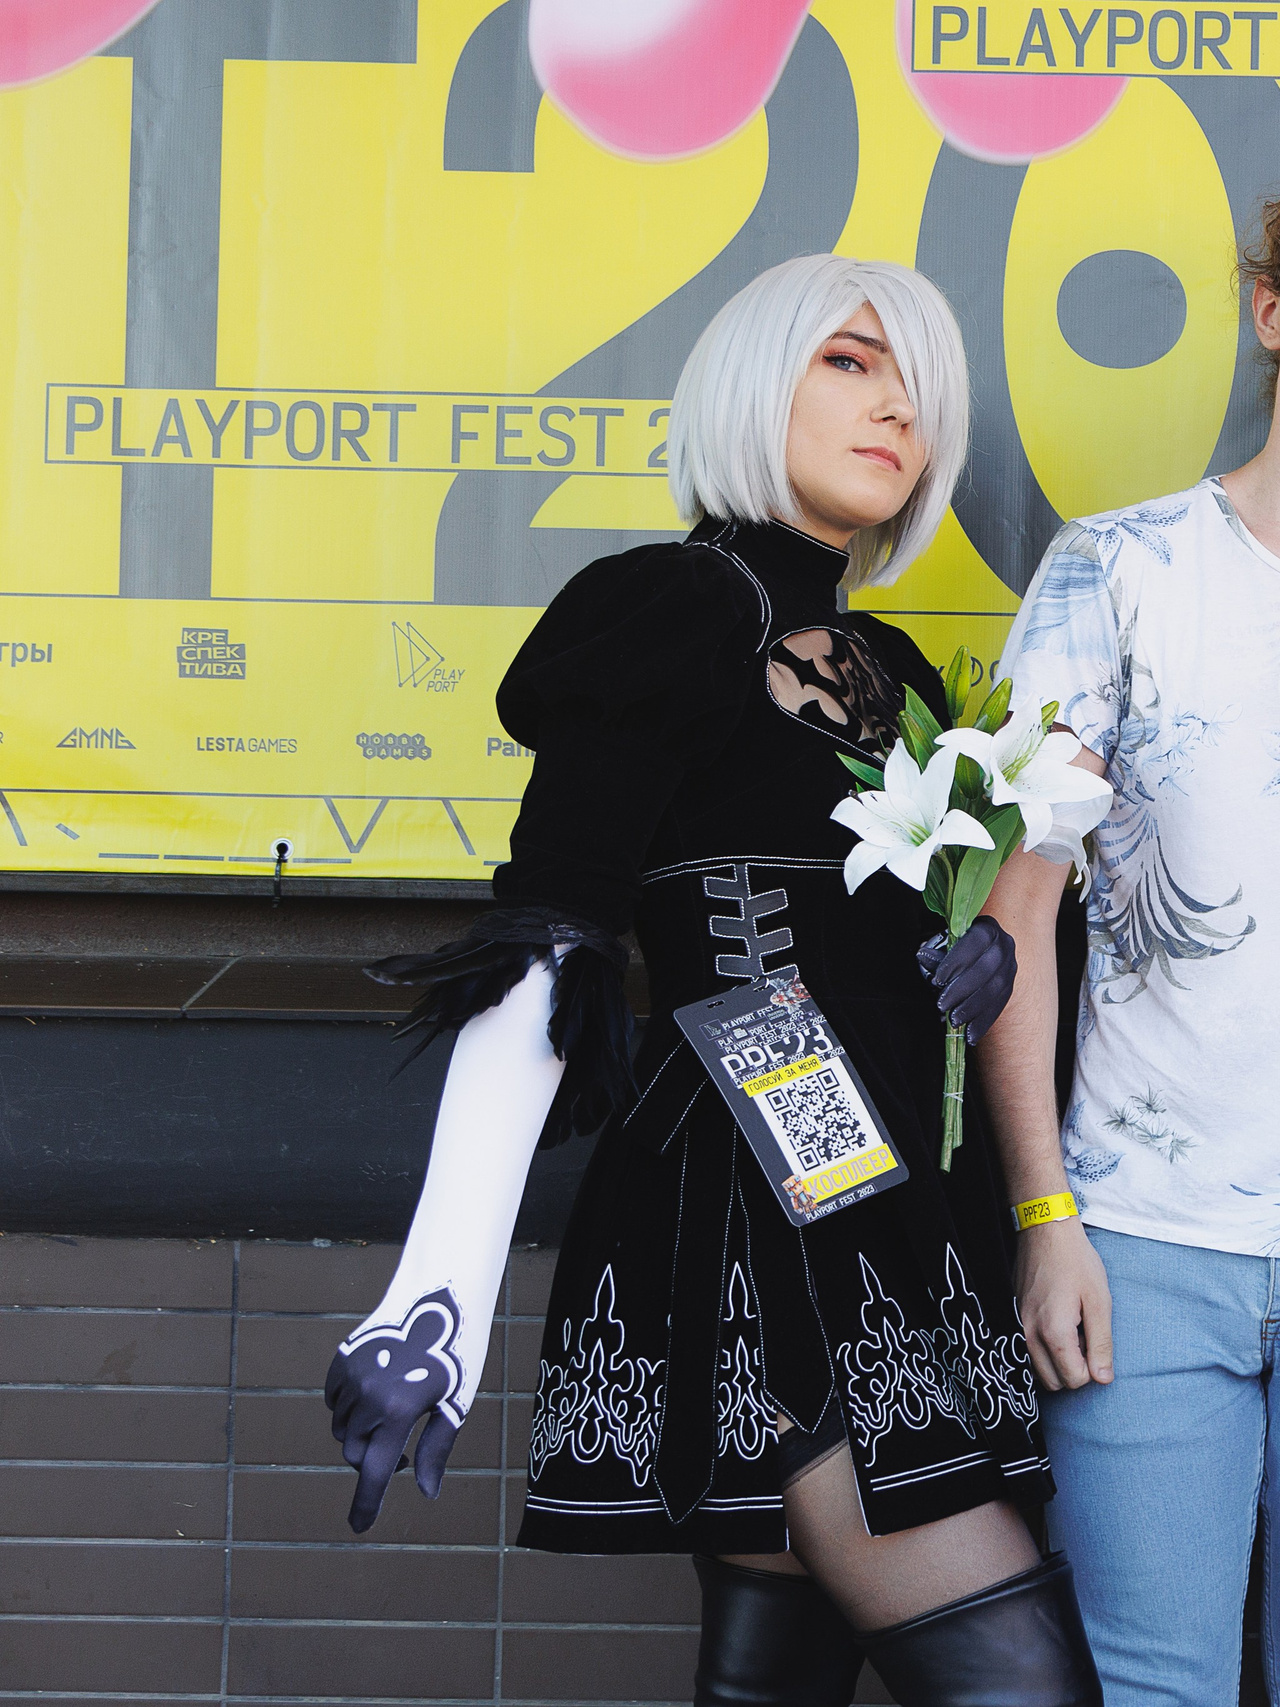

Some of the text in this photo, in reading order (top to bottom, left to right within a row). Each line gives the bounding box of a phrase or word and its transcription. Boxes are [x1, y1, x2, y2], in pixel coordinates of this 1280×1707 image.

[932, 6, 1277, 71] PLAYPORT
[65, 396, 417, 463] PLAYPORT
[451, 405, 624, 466] FEST
[183, 630, 226, 645] КРЕ
[181, 646, 240, 661] СПЕК
[181, 661, 244, 676] ТИВА
[433, 669, 466, 681] PLAY
[426, 681, 459, 693] PORT
[197, 737, 298, 753] LESTA GAMES
[358, 734, 423, 746] HOBBY
[364, 747, 429, 758] GAMES
[722, 1013, 756, 1031] PLAYPORT
[725, 1037, 758, 1054] PLAYPORT
[760, 1029, 778, 1040] FEST
[779, 1022, 797, 1034] 2023
[770, 1060, 786, 1071] FEST
[788, 1052, 806, 1064] 2023
[748, 1058, 819, 1092] ГОЛОСУЙ ЗА МЕНЯ
[808, 1148, 889, 1197] КОСПЛЕЕР
[805, 1185, 875, 1221] PLAYPORT FEST 2023
[1023, 1202, 1051, 1222] PPF23
